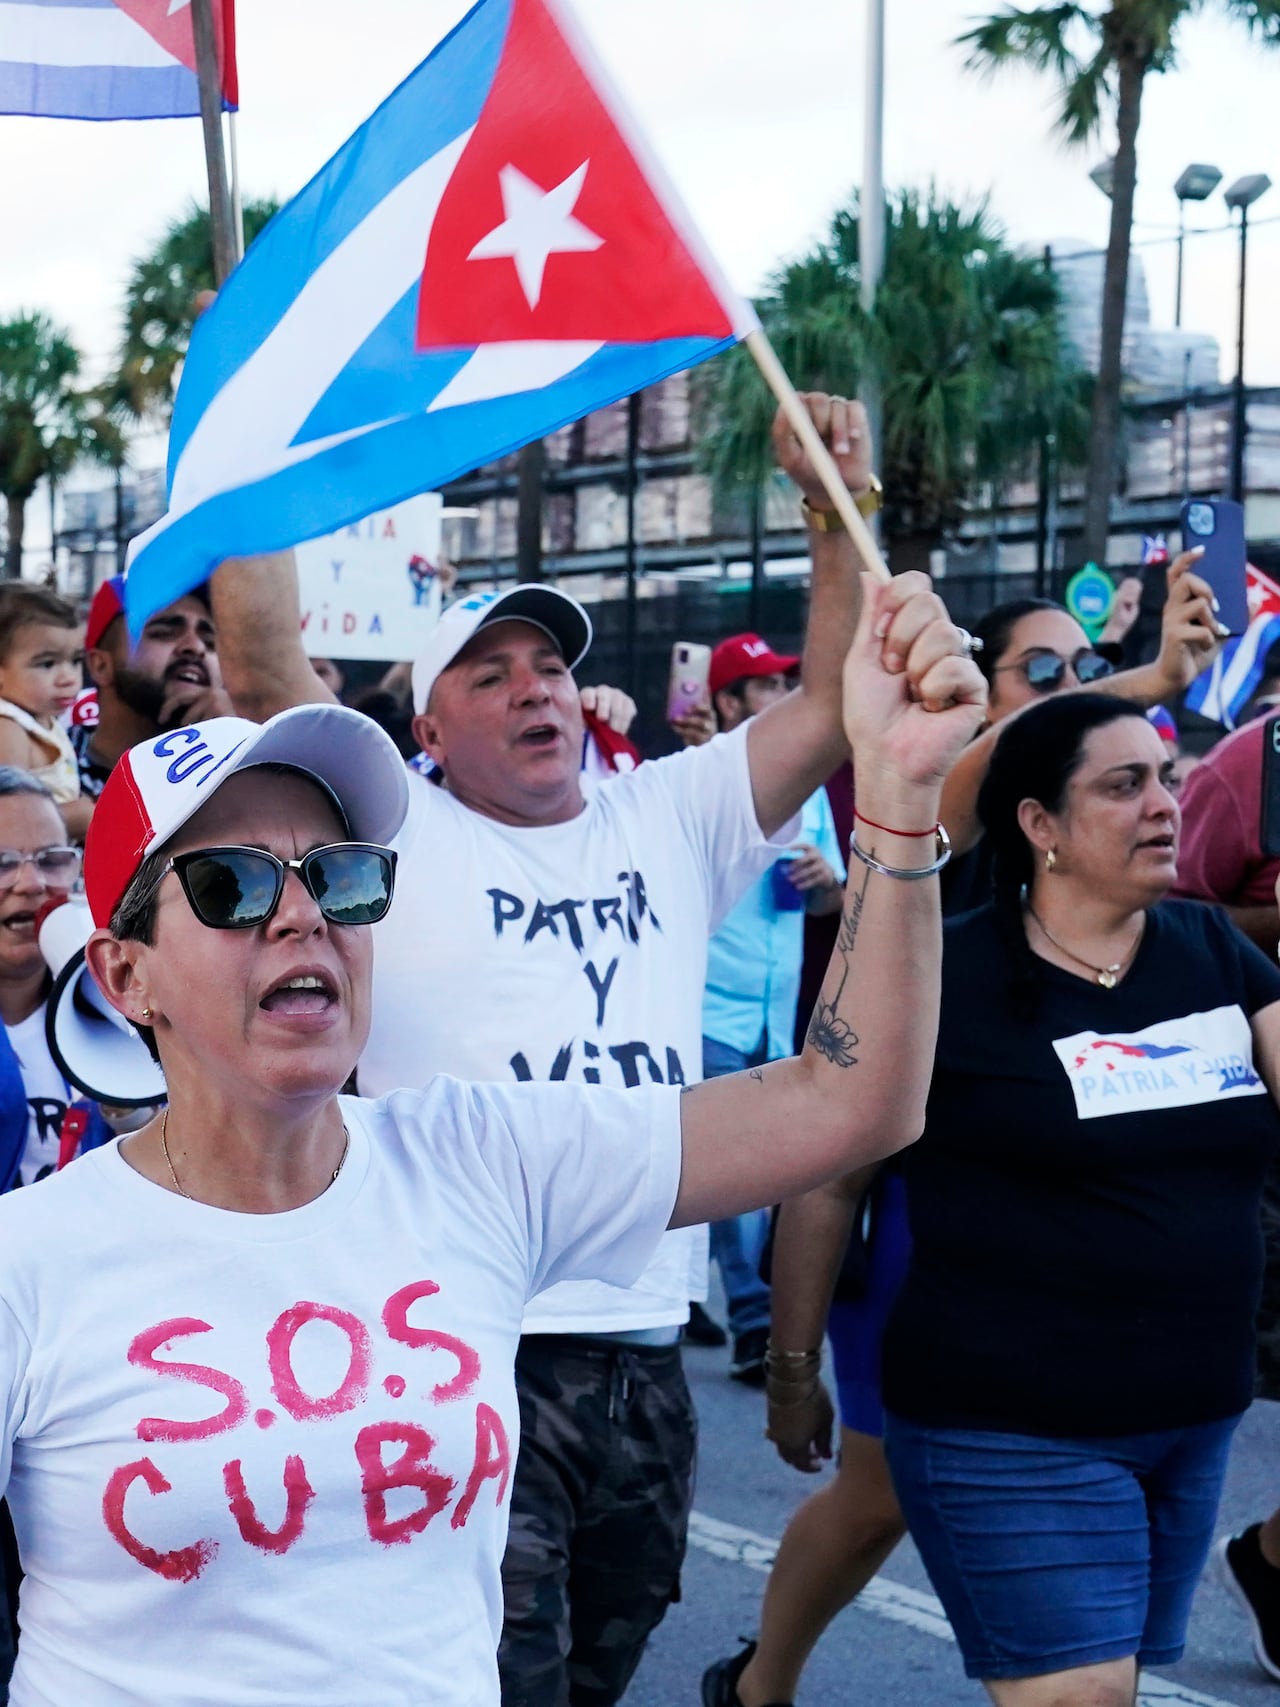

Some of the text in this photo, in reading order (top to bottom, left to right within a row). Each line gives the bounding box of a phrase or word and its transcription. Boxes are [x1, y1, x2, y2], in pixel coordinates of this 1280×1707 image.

[330, 559, 345, 584] Y
[582, 956, 620, 1031] Y
[1080, 1070, 1179, 1101] PATRIA
[1180, 1063, 1201, 1087] Y
[126, 1279, 482, 1443] S.O.S
[102, 1402, 511, 1584] CUBA
